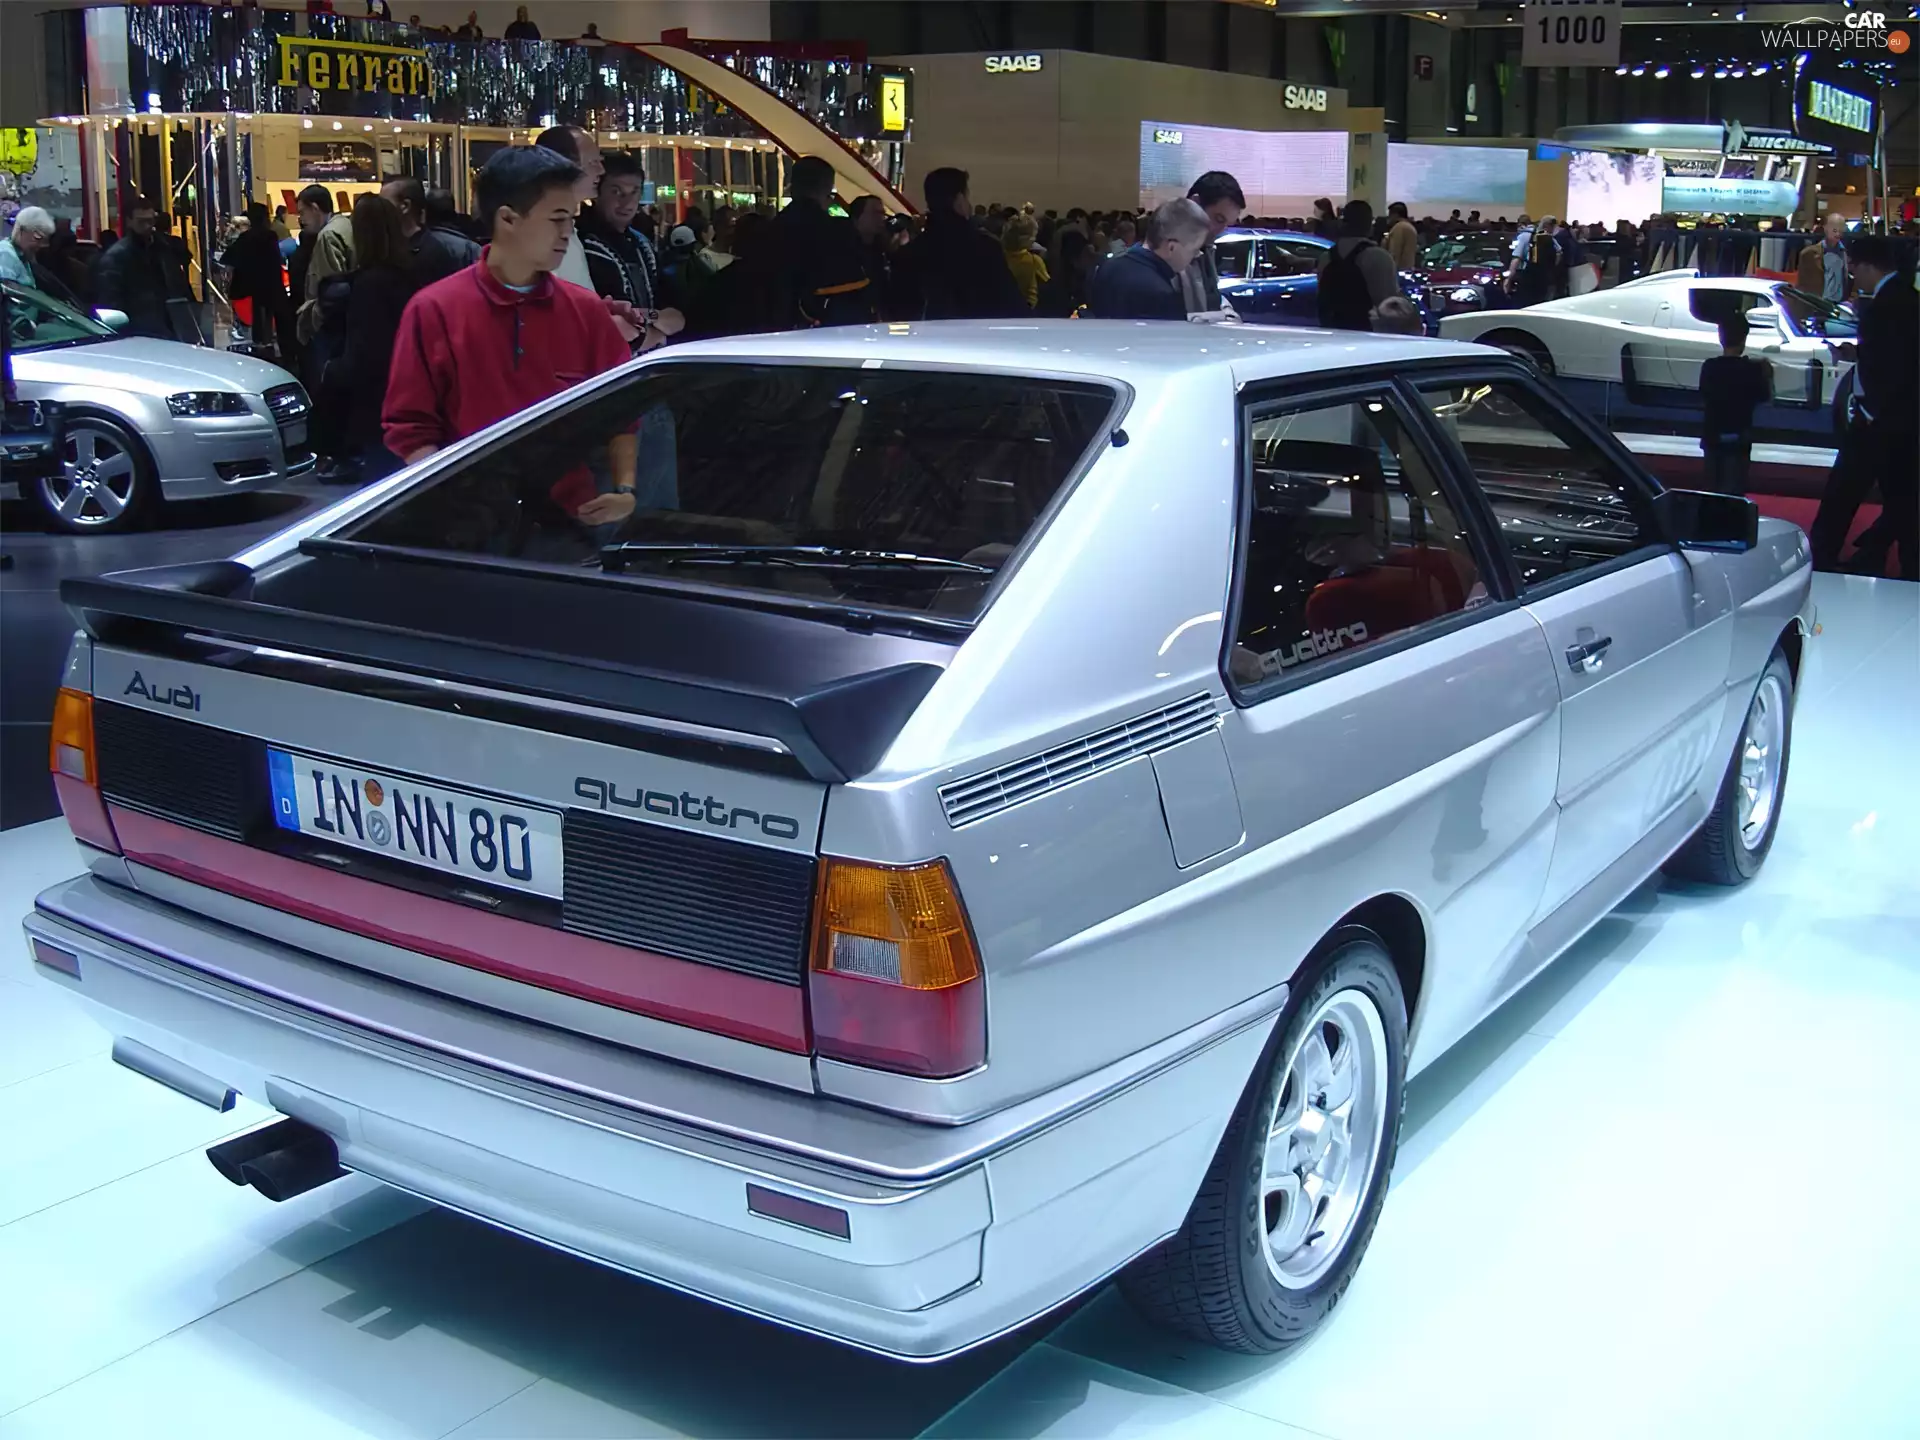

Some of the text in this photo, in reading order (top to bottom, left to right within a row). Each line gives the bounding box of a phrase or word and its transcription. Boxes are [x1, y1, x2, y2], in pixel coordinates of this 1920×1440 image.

[1538, 16, 1606, 44] 1000
[277, 35, 434, 98] Ferrari
[985, 54, 1041, 73] SAAB
[1284, 85, 1327, 112] SAAB
[1155, 130, 1182, 145] SAAB
[1259, 621, 1369, 676] quattro
[123, 670, 201, 712] Audi
[311, 769, 533, 882] IN NN 80
[574, 776, 799, 840] quattro
